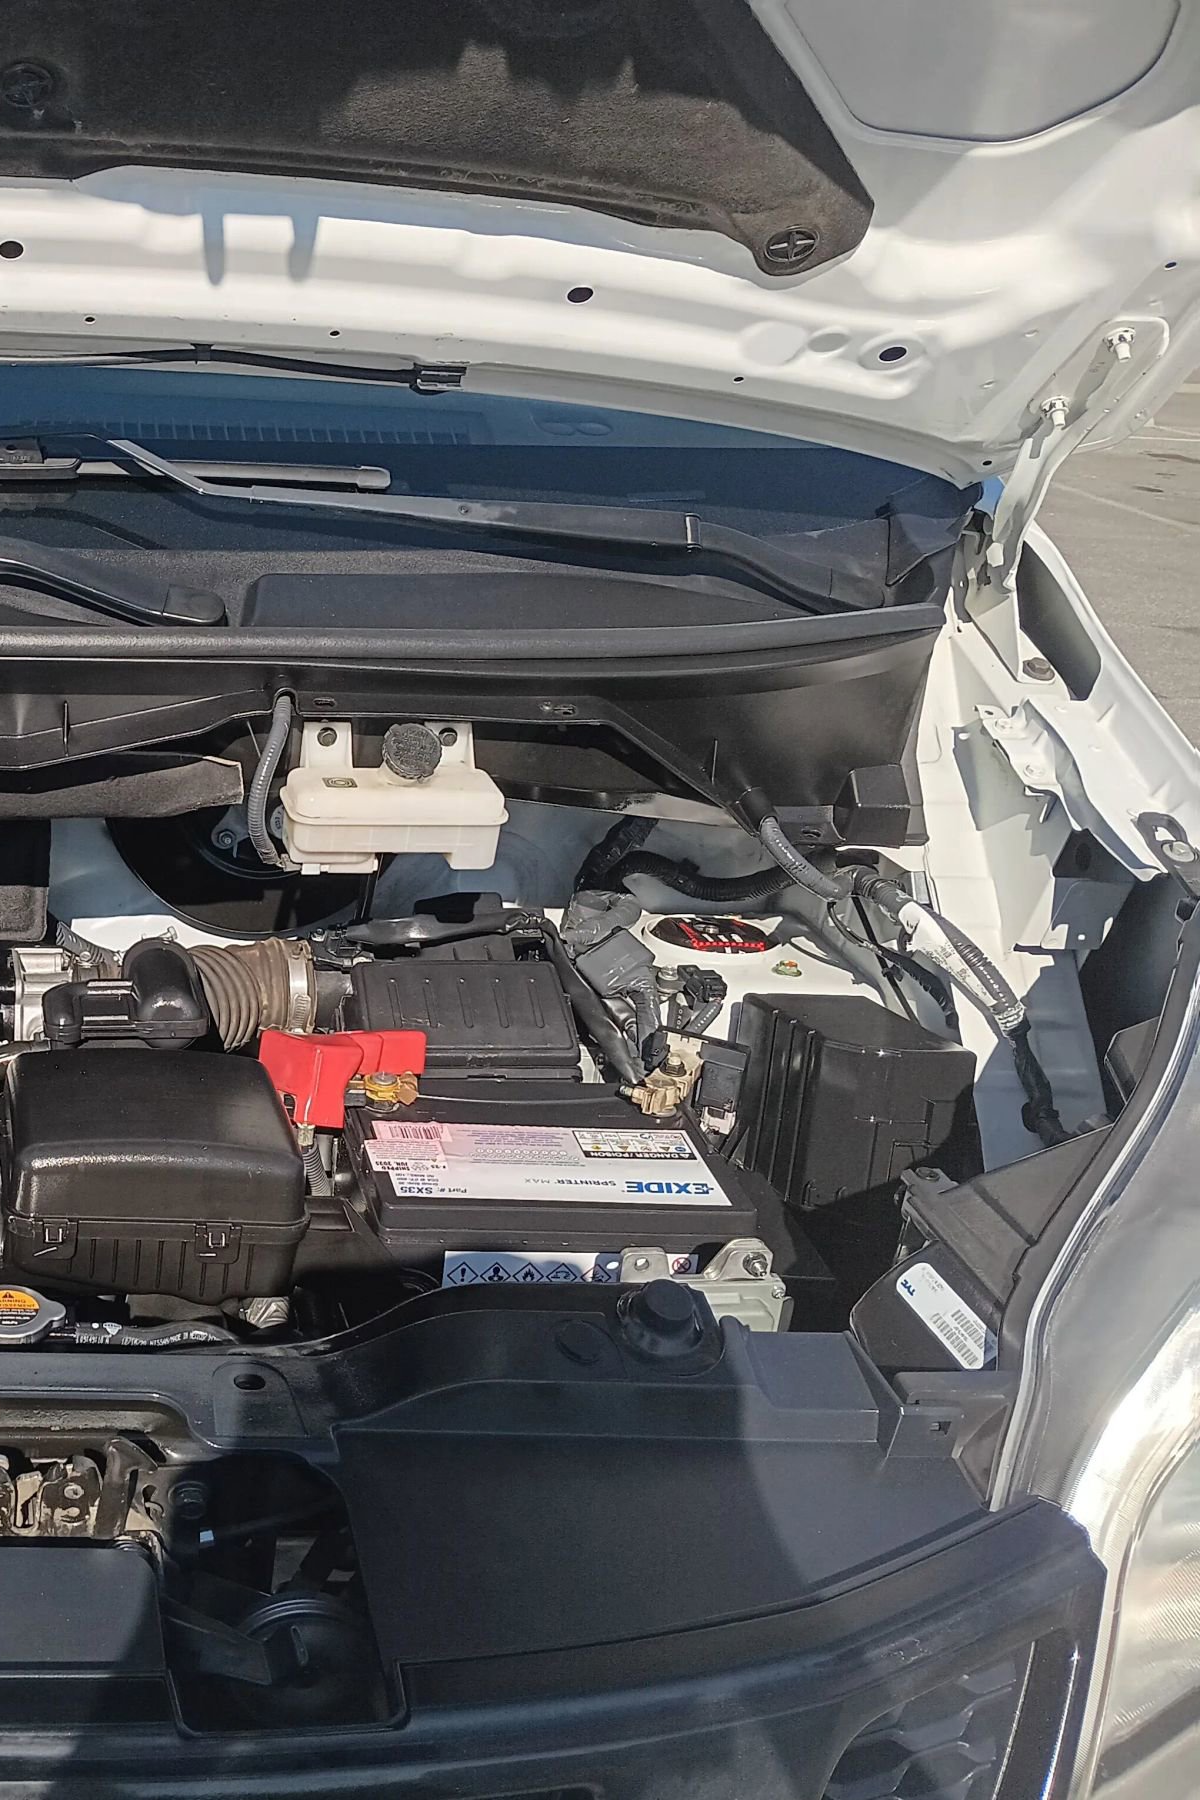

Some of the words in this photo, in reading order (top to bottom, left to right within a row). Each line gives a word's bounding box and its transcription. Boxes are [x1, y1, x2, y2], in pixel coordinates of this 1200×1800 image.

[556, 1178, 617, 1186] SPRINTER
[400, 1186, 433, 1195] SX35
[625, 1181, 714, 1195] EXIDE
[900, 1279, 916, 1297] TYC
